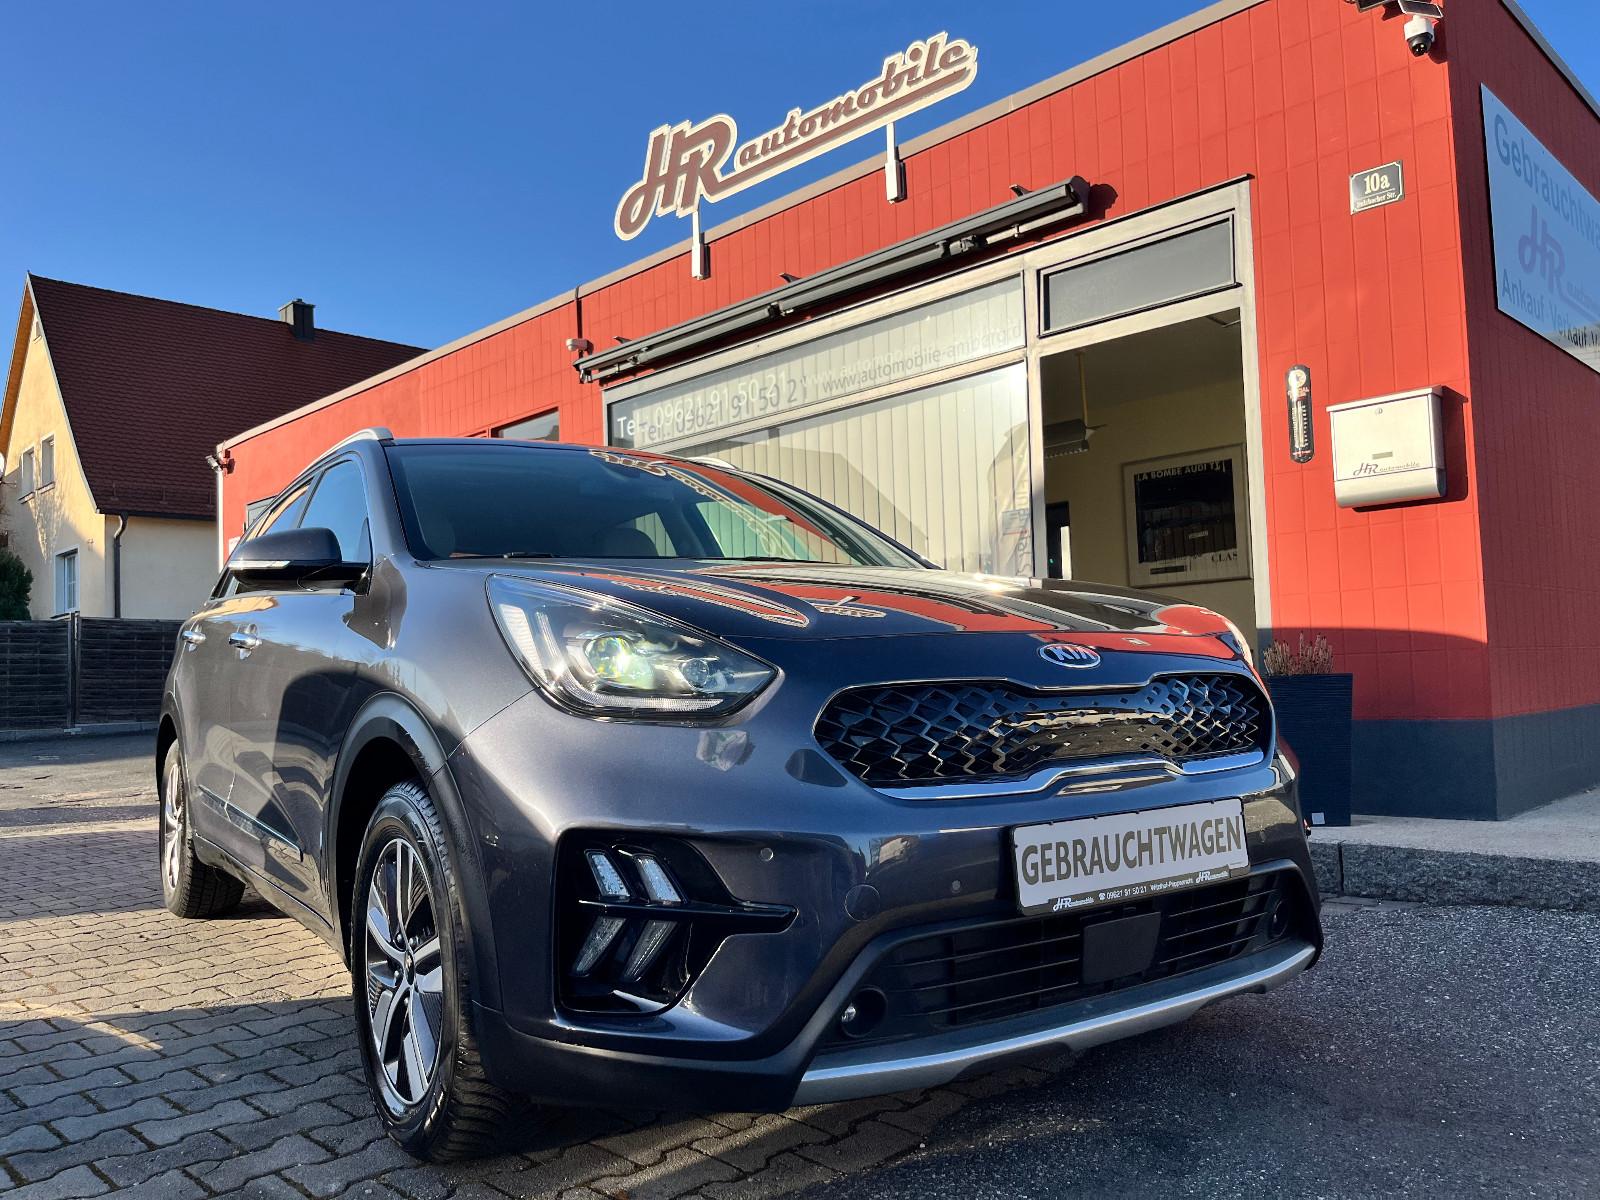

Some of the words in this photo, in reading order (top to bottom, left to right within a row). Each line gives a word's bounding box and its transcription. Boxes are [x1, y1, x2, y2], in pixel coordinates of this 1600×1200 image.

[738, 36, 975, 168] automobile
[1364, 173, 1390, 194] 10a
[1502, 269, 1544, 322] Ankauf
[1185, 463, 1206, 473] AUDI
[1021, 815, 1242, 885] GEBRAUCHTWAGEN
